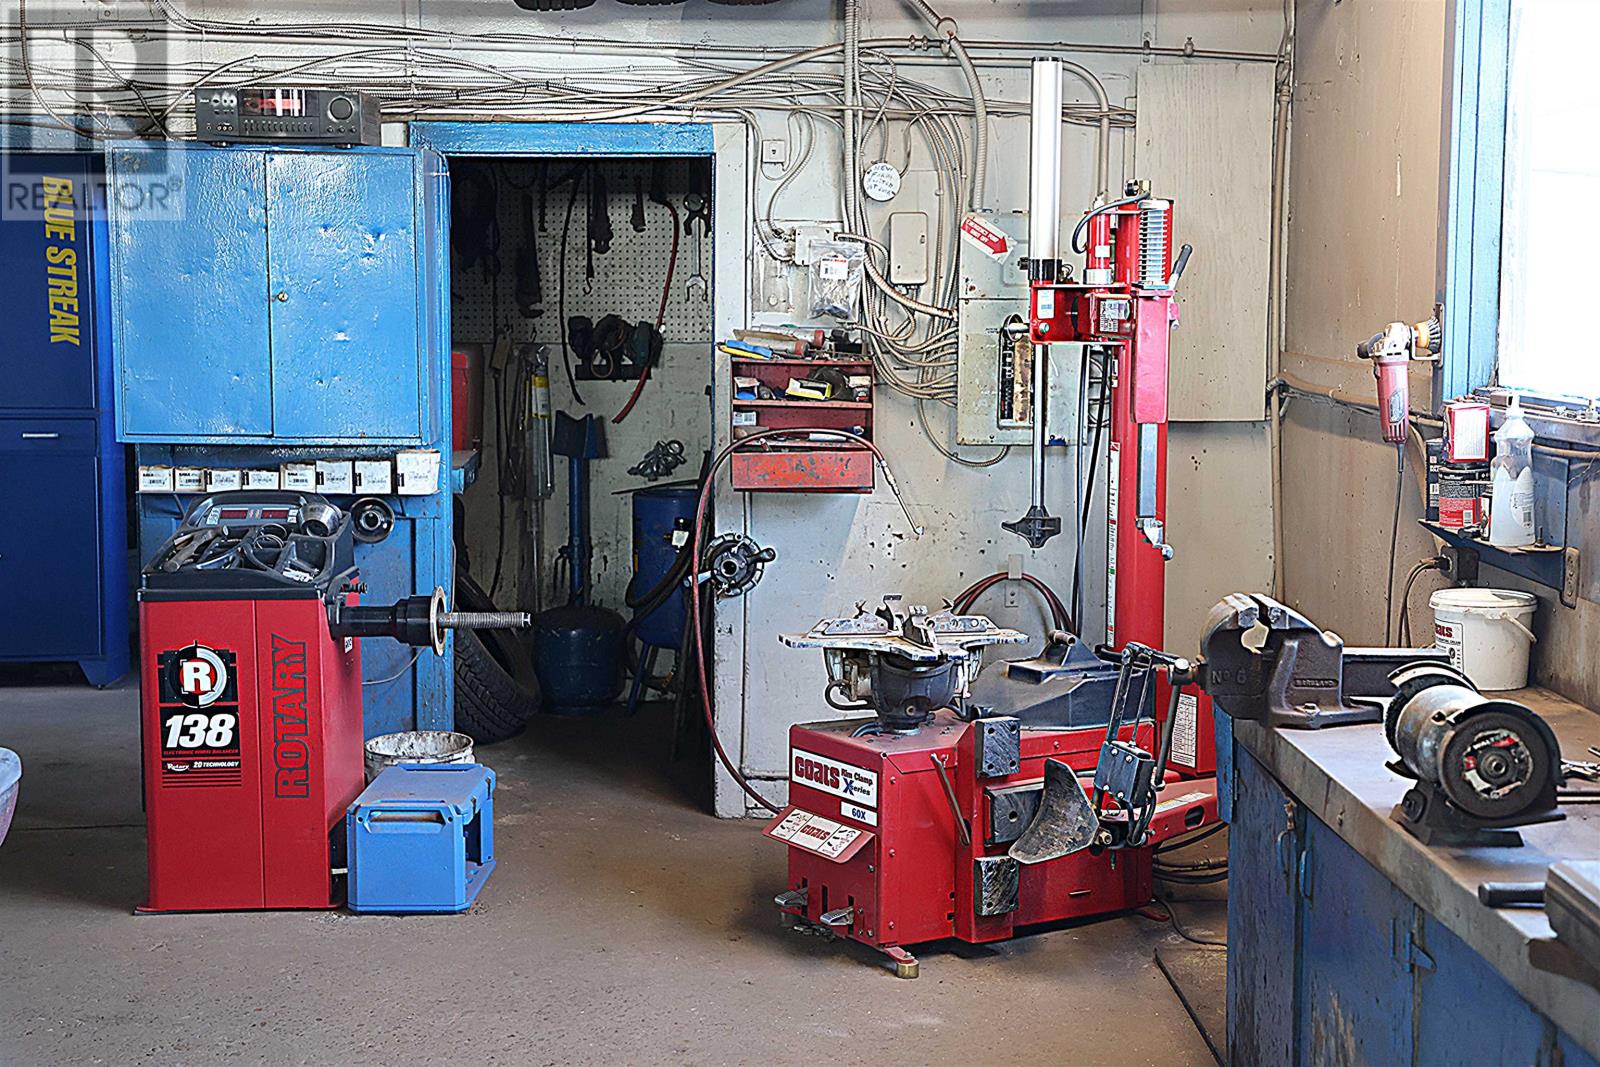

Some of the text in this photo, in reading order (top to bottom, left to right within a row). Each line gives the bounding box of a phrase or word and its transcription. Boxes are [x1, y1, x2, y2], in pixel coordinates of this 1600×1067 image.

[43, 176, 80, 346] BLUE STREAK
[183, 661, 213, 692] R
[1236, 666, 1248, 684] 6
[272, 633, 310, 798] ROTARY
[165, 713, 236, 748] 138
[166, 762, 190, 772] Rotary
[841, 768, 853, 779] Rim
[854, 773, 873, 787] Clamp
[851, 807, 866, 820] 60X
